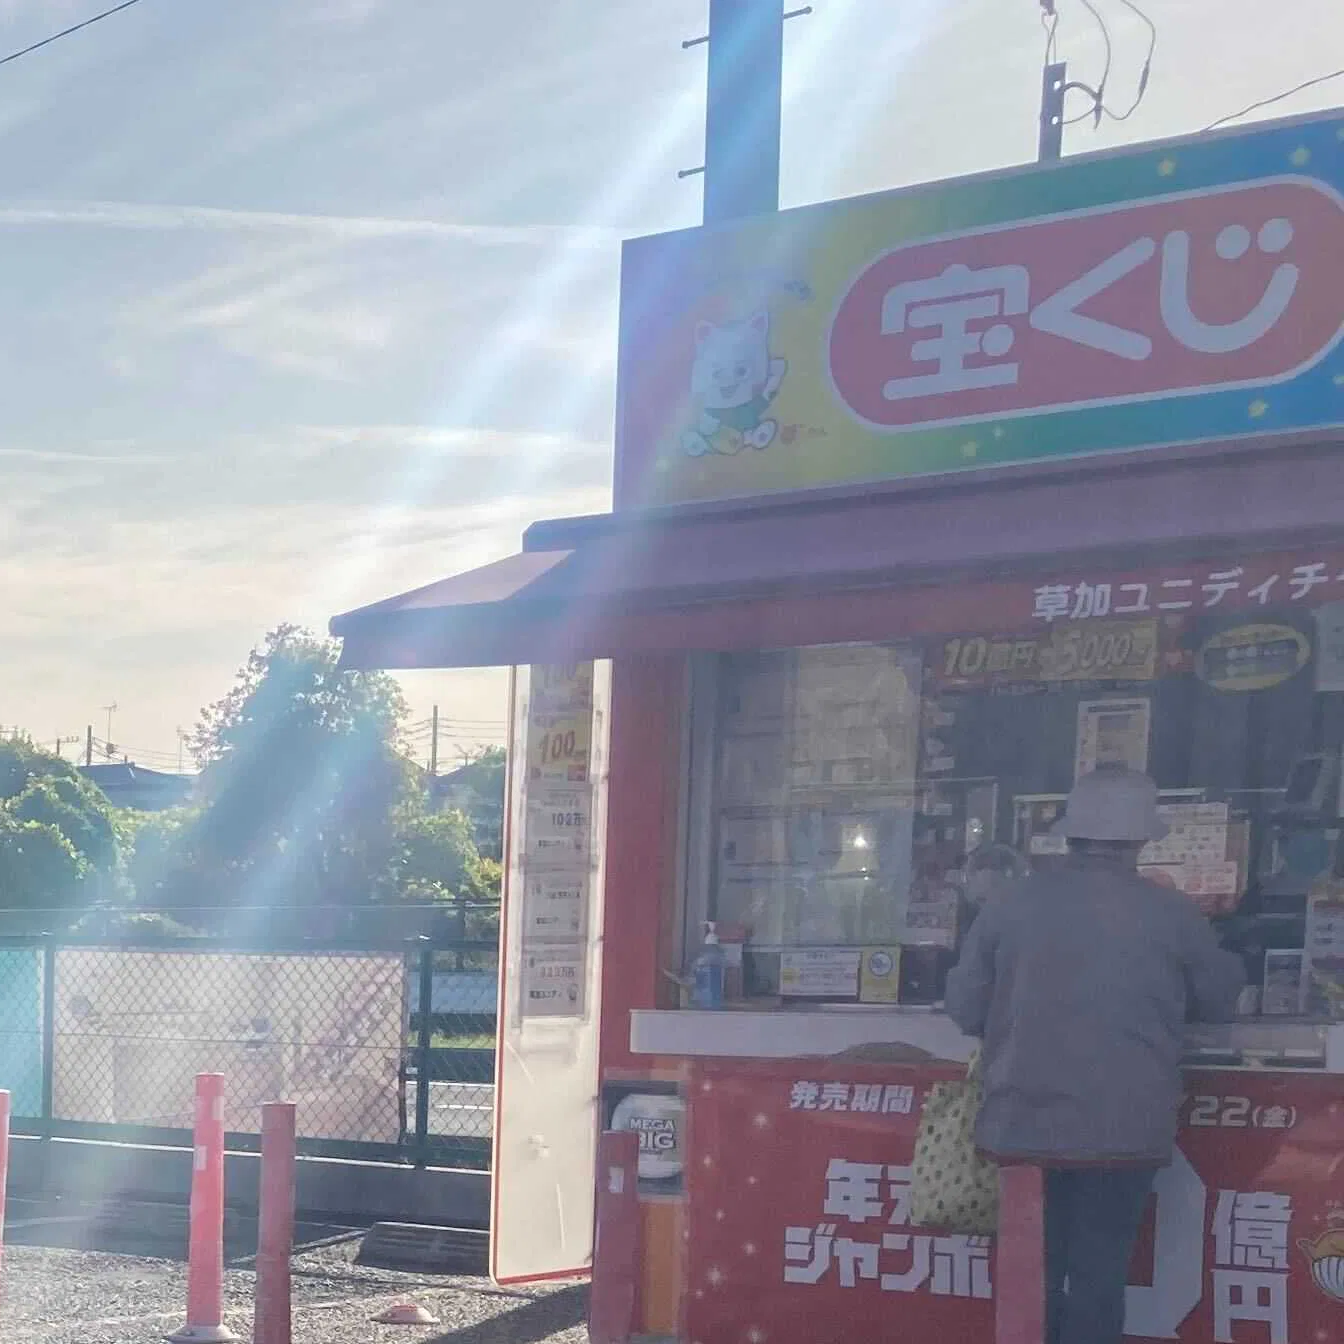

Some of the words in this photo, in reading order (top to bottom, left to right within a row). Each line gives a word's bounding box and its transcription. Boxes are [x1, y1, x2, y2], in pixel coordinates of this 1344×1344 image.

[880, 216, 1300, 401] 宝くじ
[1032, 562, 1344, 622] 草加ユニディチ
[629, 1117, 675, 1130] MEGA
[789, 1080, 914, 1114] 発売期間
[783, 1223, 994, 1300] ジャンボ
